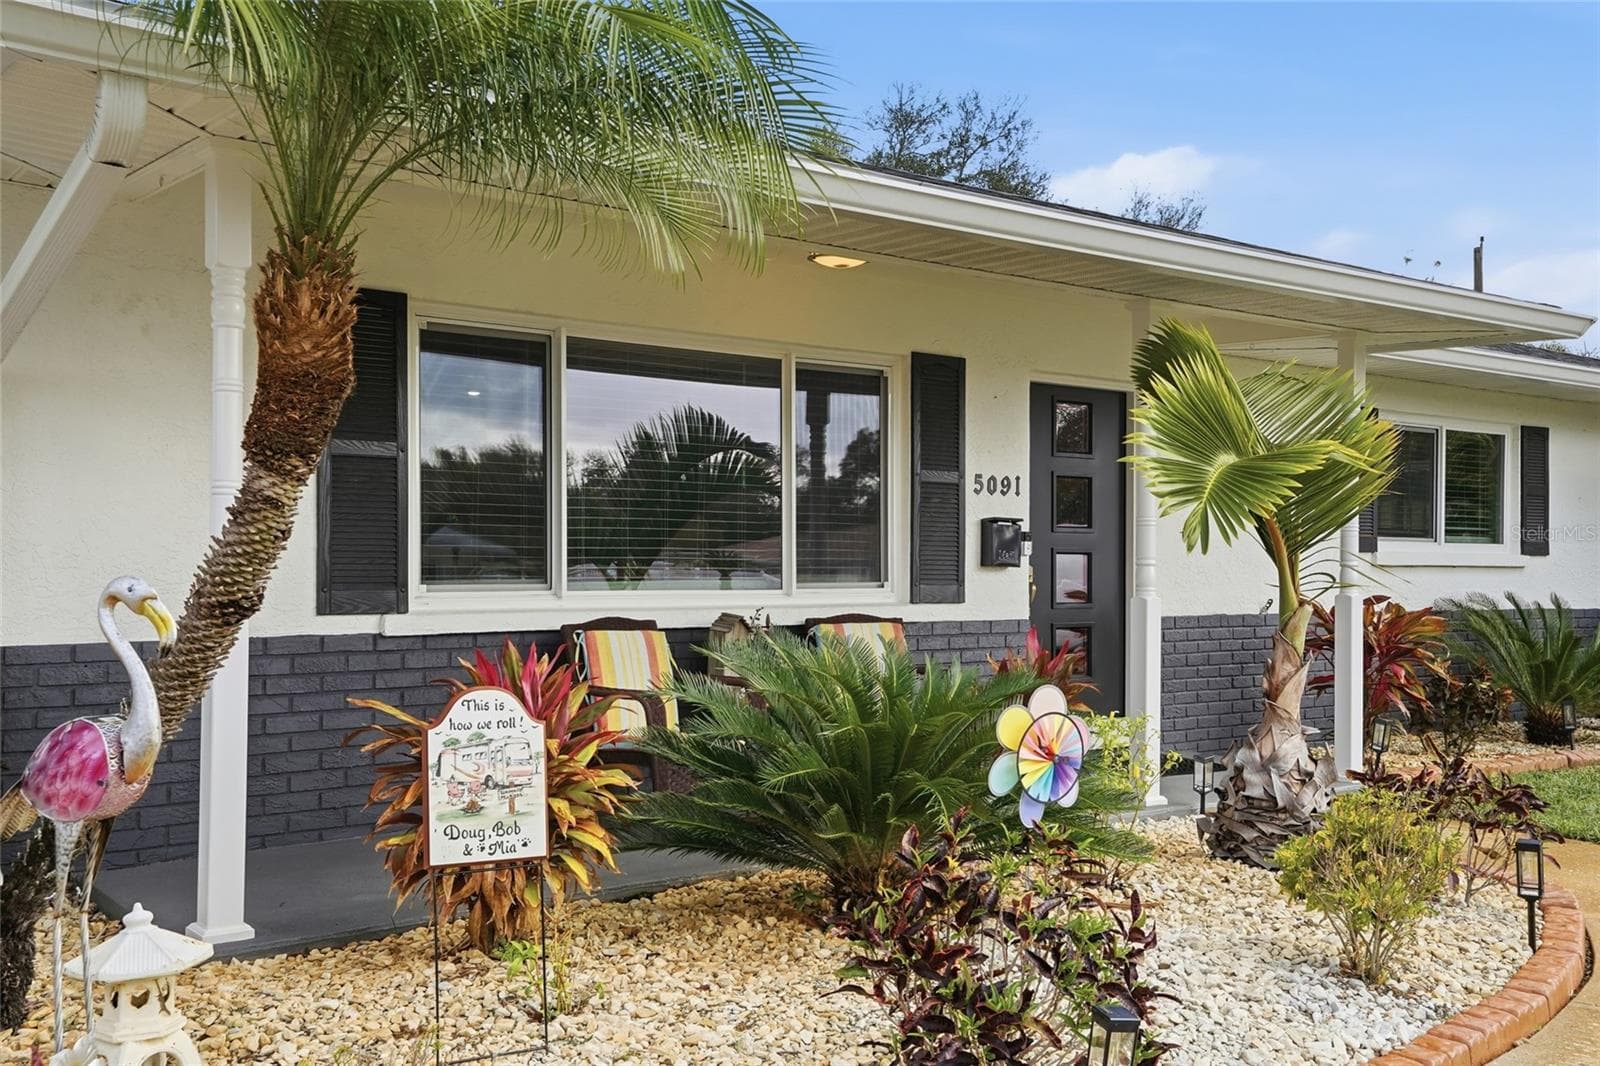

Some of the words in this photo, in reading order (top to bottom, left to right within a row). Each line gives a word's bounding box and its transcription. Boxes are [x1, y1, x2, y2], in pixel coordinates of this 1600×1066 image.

[973, 473, 1021, 497] 5091
[461, 698, 490, 712] This
[494, 698, 505, 712] is
[449, 718, 473, 731] how
[477, 720, 492, 730] we
[443, 824, 492, 842] Doug,
[492, 820, 521, 837] Bob
[462, 843, 473, 857] &
[487, 840, 517, 856] Mia
